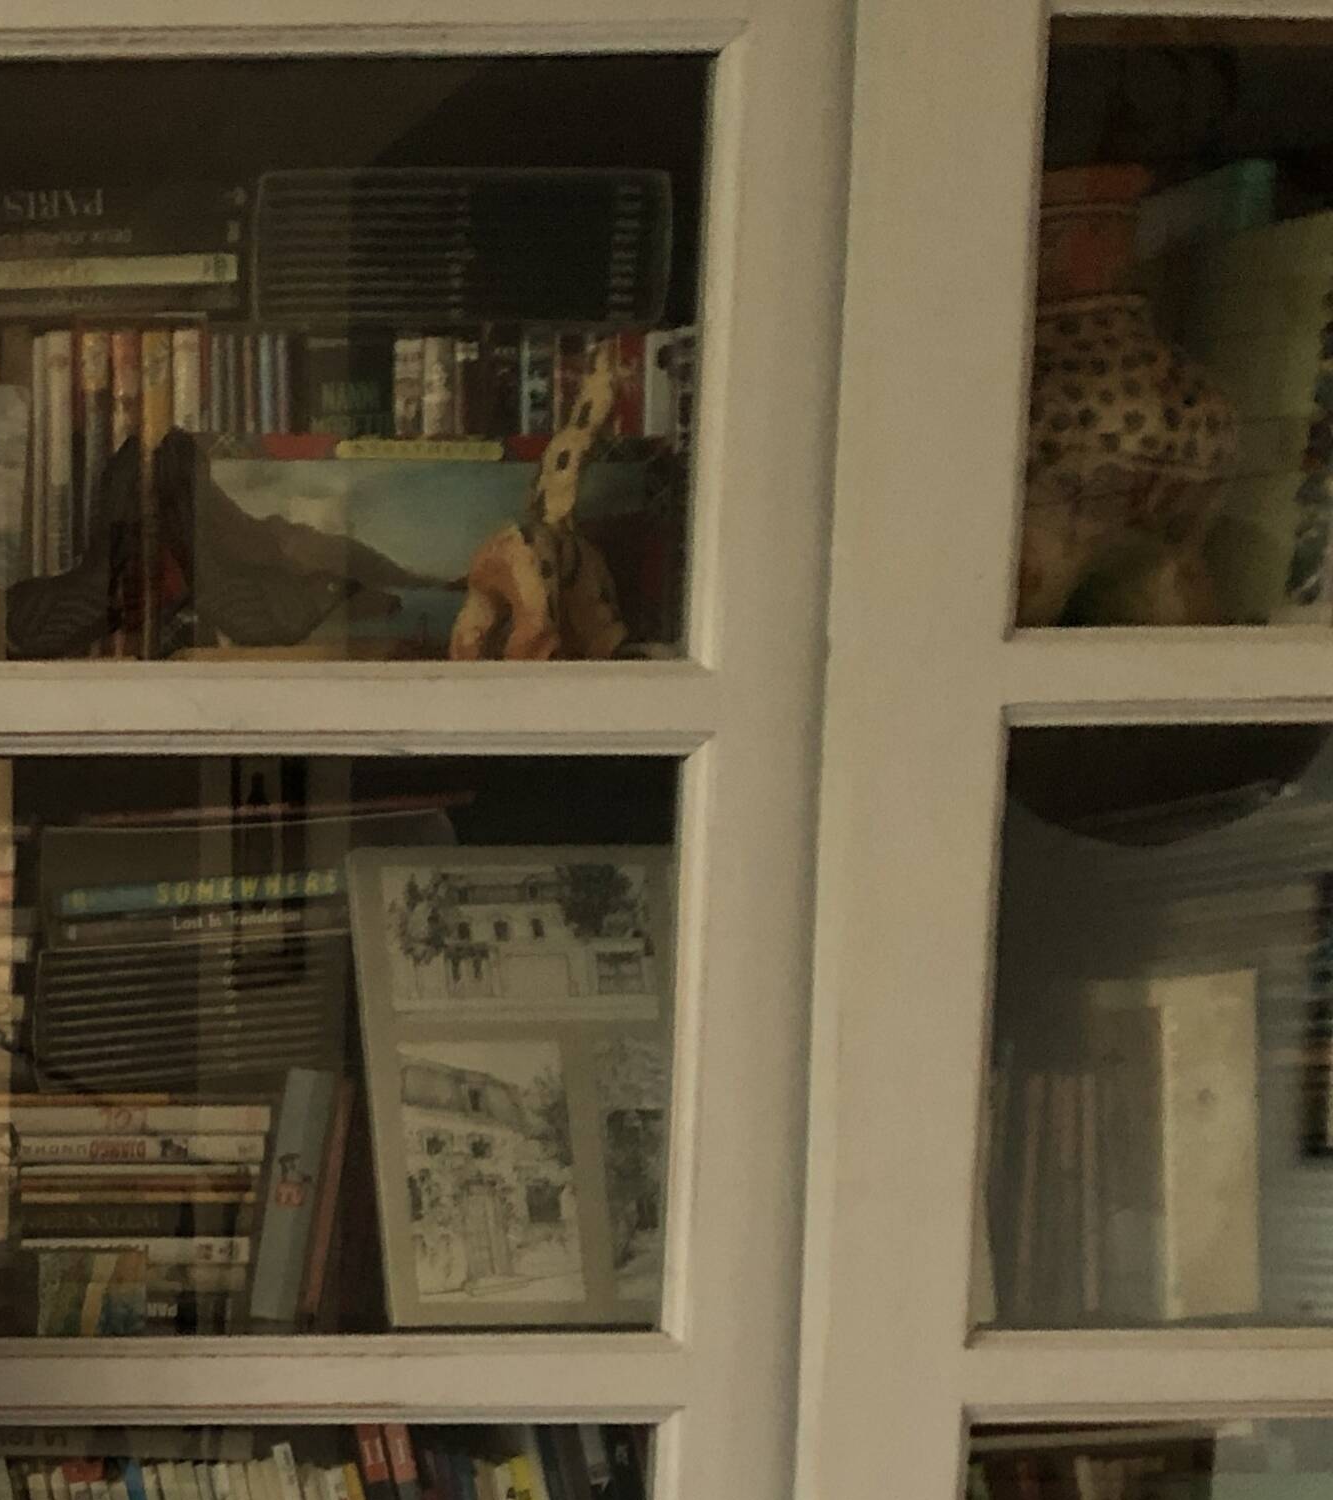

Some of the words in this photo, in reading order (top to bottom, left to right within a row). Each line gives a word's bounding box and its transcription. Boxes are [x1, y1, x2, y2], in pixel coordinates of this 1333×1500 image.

[3, 188, 103, 218] PARIS
[154, 866, 338, 907] SOMEWHERE
[171, 915, 204, 932] Lost
[227, 905, 301, 927] Translation
[89, 1140, 145, 1158] DJANGO
